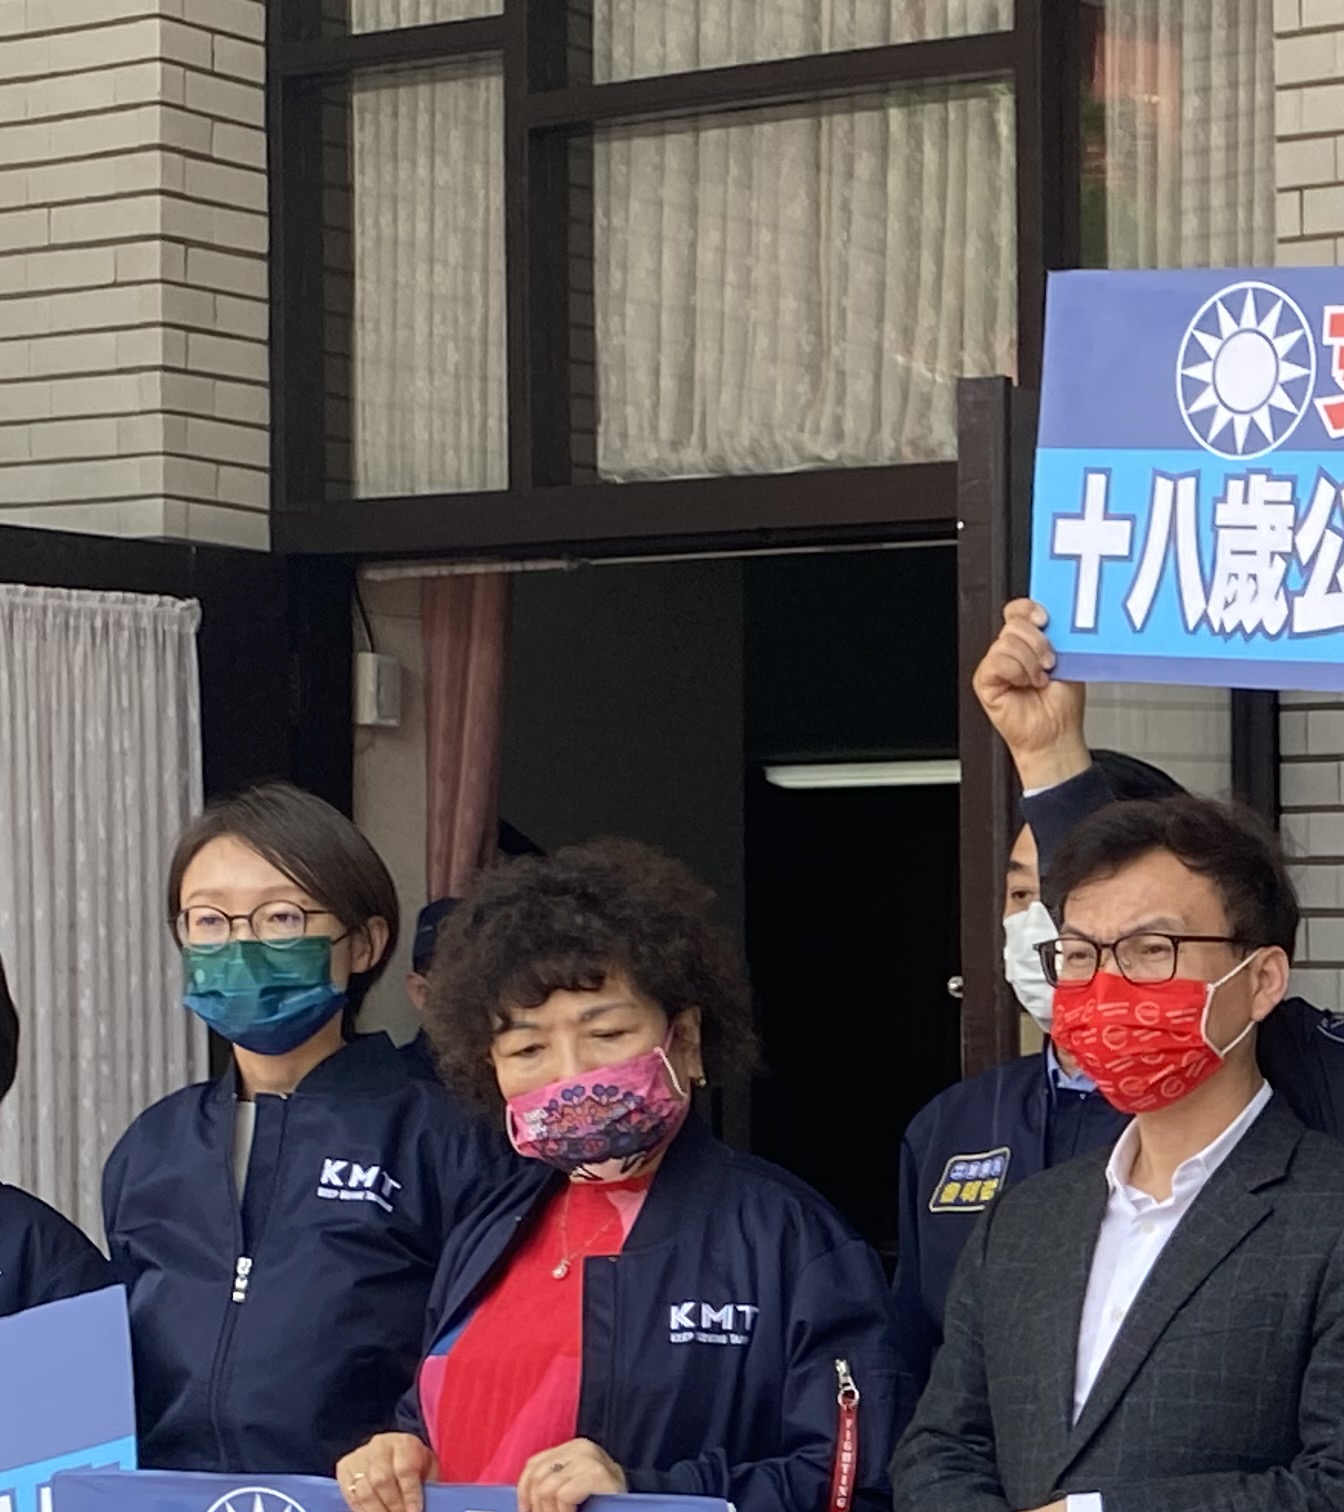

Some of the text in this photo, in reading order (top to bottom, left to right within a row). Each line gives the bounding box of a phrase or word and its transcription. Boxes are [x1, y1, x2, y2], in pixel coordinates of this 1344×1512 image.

[320, 1158, 402, 1197] KMT
[670, 1301, 760, 1331] KMT
[835, 1418, 853, 1509] FIGHTING
